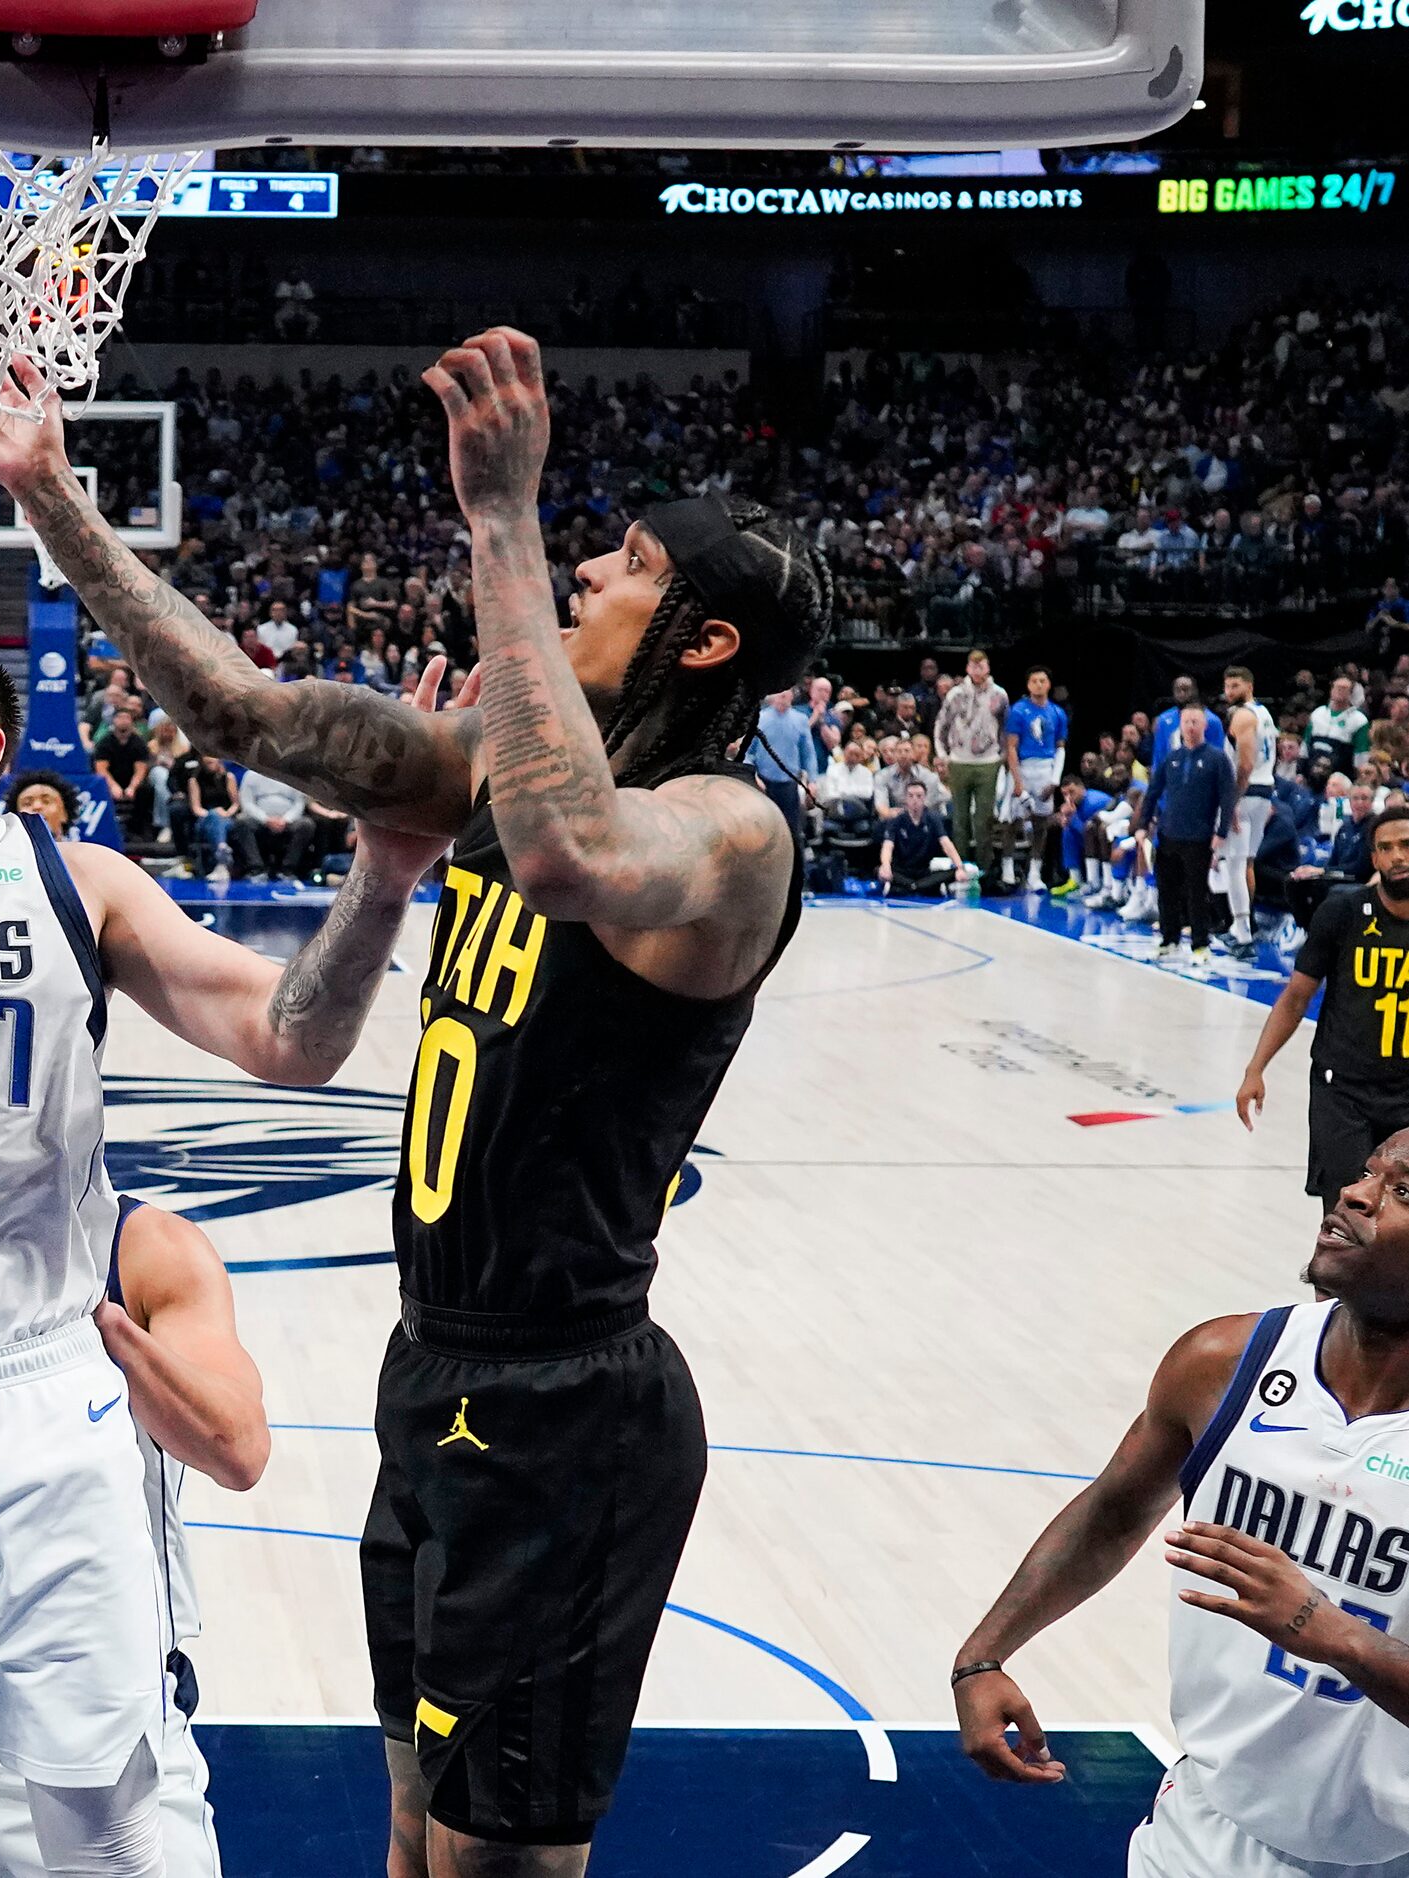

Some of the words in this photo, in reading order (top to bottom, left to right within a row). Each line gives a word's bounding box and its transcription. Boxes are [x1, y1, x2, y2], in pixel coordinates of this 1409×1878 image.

[229, 191, 246, 211] 3
[288, 192, 305, 211] 4
[678, 183, 851, 214] CHOCTAW
[850, 191, 952, 211] CASINOS
[957, 191, 974, 209] &
[979, 189, 1083, 209] RESORTS
[1158, 179, 1208, 213] BIG
[1214, 175, 1316, 212] GAMES
[1321, 169, 1396, 213] 24/7
[1264, 1373, 1293, 1404] 6
